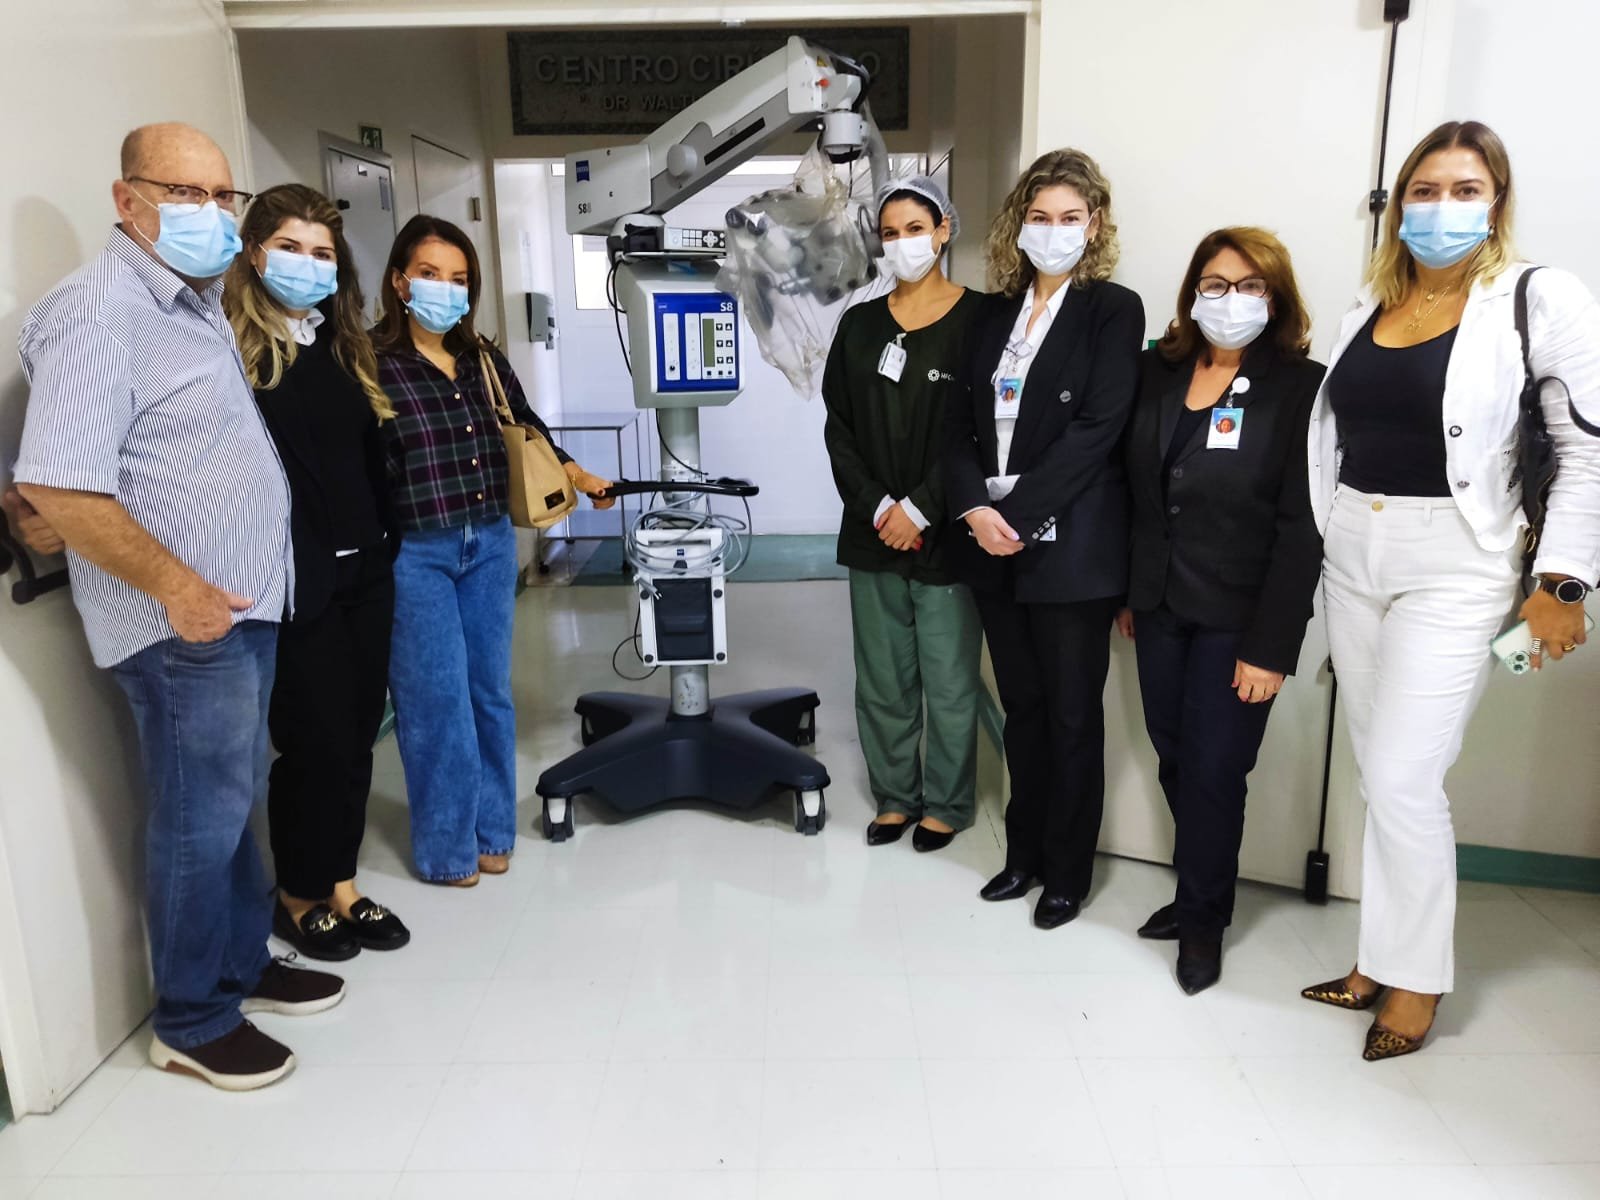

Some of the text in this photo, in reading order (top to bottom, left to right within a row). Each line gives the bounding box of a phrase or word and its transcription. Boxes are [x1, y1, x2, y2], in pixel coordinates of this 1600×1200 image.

[534, 53, 681, 84] CENTRO
[603, 94, 698, 111] DR WALT
[720, 302, 734, 312] S8
